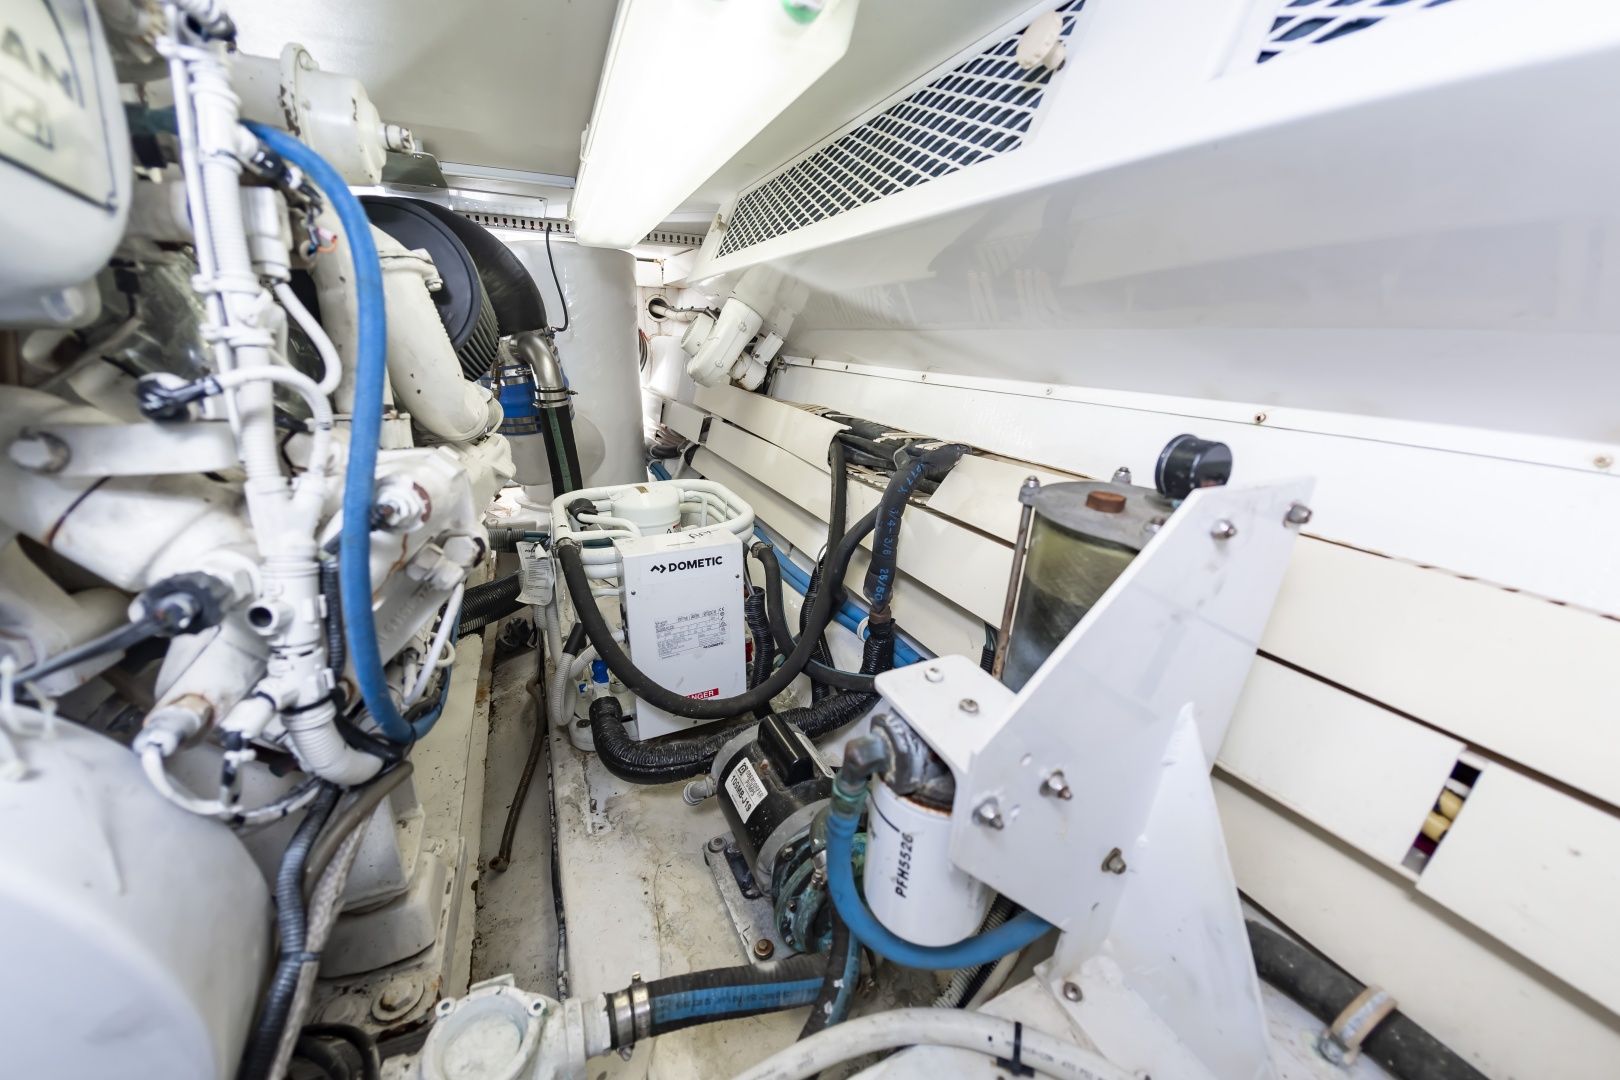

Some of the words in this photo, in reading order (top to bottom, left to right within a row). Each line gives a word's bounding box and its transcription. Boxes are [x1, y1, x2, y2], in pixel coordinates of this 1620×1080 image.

[668, 556, 723, 573] DOMETIC
[744, 780, 756, 797] PUMPS
[894, 832, 914, 899] PFH5526
